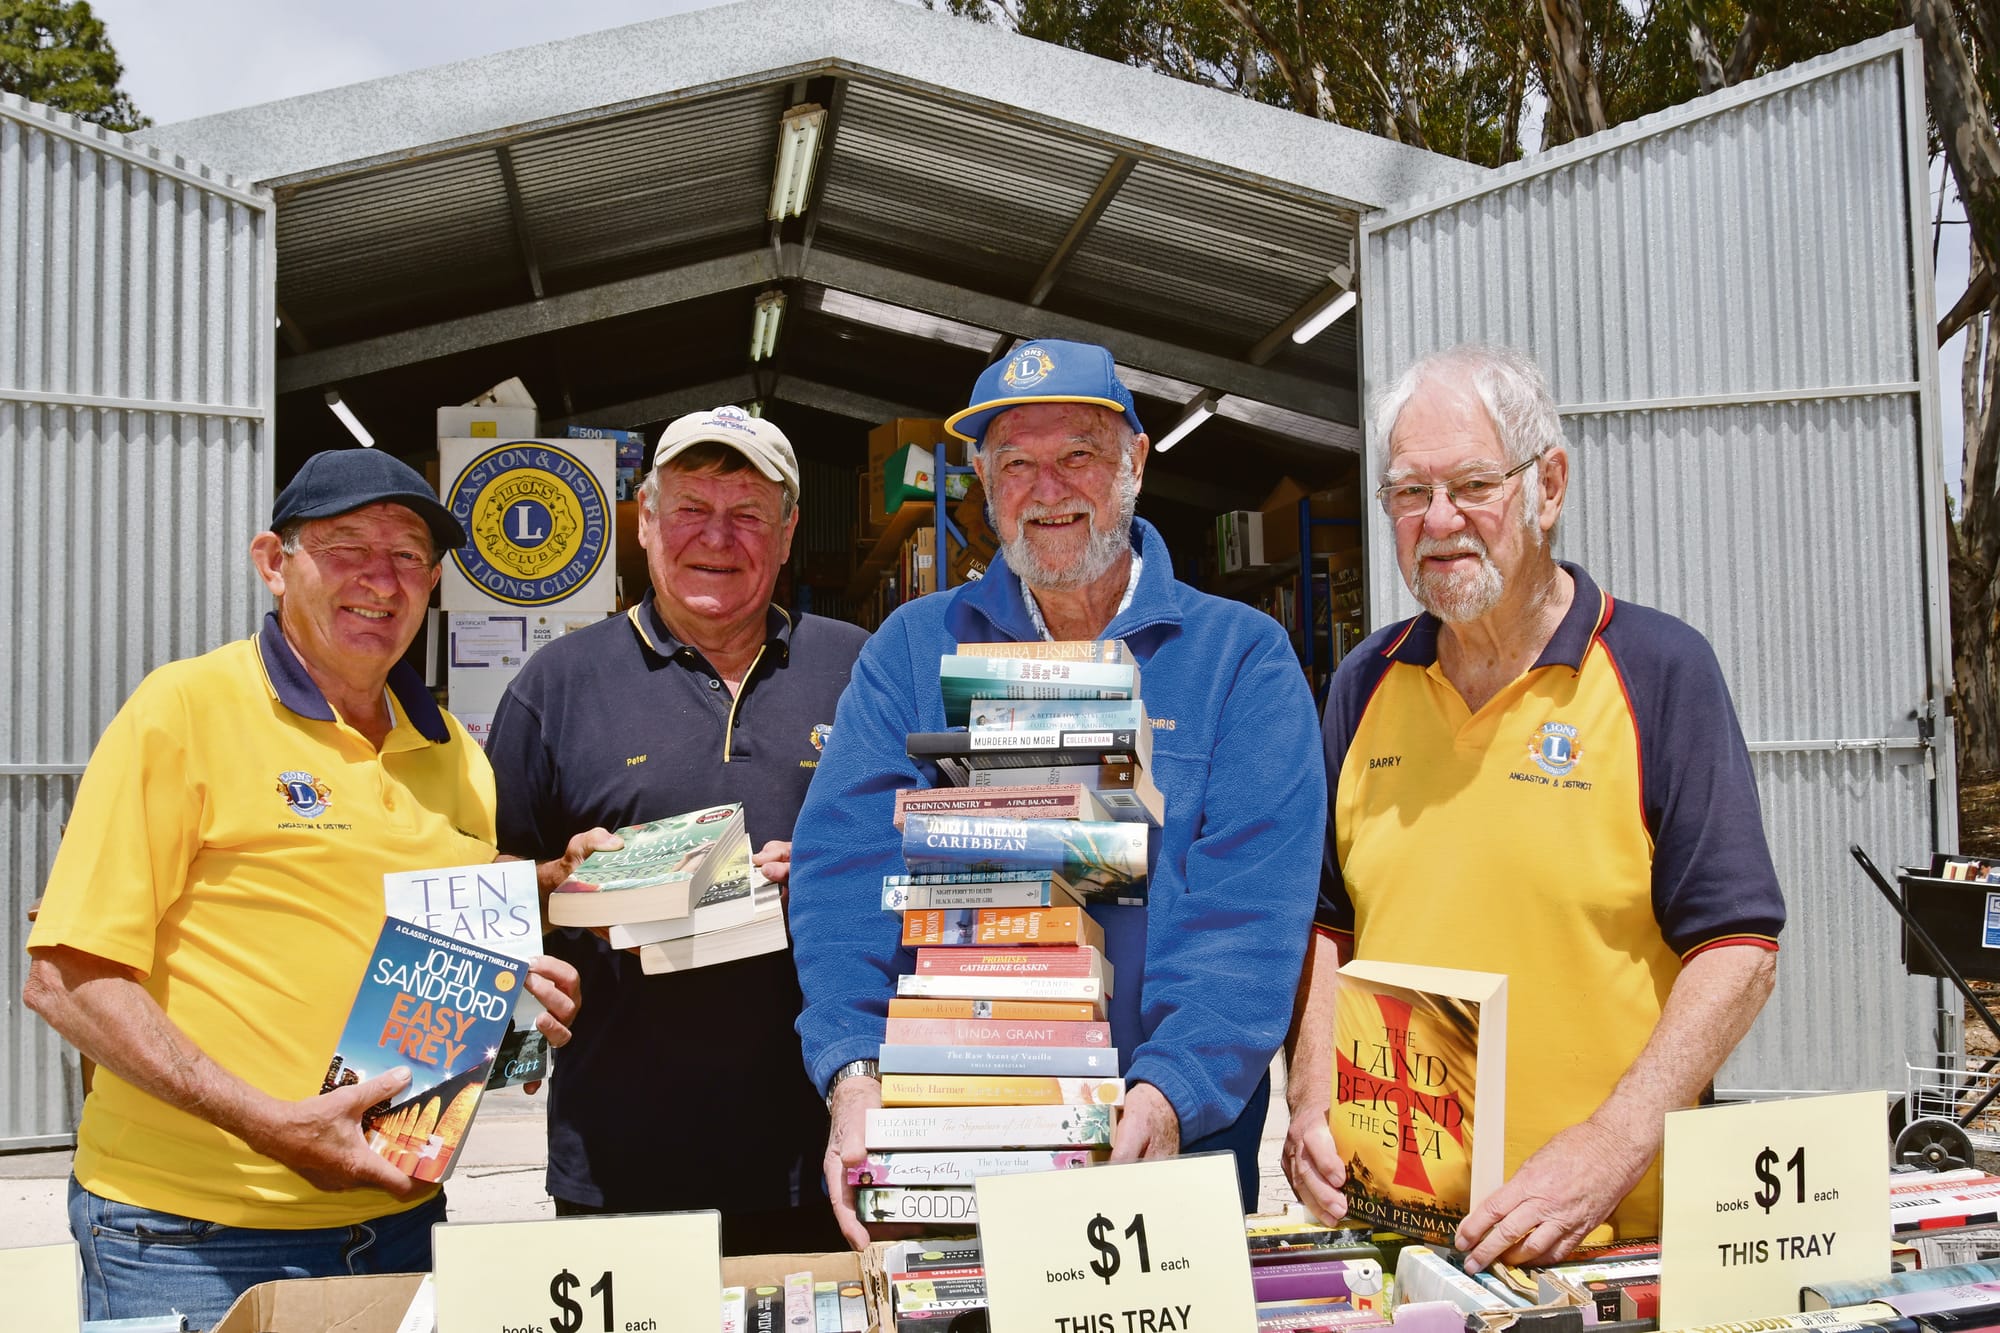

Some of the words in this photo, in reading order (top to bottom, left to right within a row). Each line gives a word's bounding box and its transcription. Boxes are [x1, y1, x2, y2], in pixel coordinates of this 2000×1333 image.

[1021, 360, 1035, 376] L
[579, 428, 603, 440] 500
[500, 481, 554, 500] LIONS
[535, 452, 549, 468] &
[555, 459, 602, 557] DISTRICT
[514, 505, 543, 539] L
[507, 551, 549, 564] CLUB
[470, 560, 535, 599] LIONS
[540, 560, 586, 596] CLUB
[1036, 643, 1097, 659] ERSKINE
[467, 723, 481, 732] No
[1543, 722, 1577, 738] LIONS
[974, 735, 1018, 746] MURDERER
[1020, 734, 1031, 746] NO
[1033, 735, 1056, 746] MORE
[1066, 736, 1094, 744] COLLEEN
[1548, 736, 1568, 761] L
[626, 754, 648, 767] Peter
[1369, 756, 1402, 769] BARRY
[280, 771, 313, 784] LIONS
[1508, 772, 1550, 785] ANGASTON
[1552, 779, 1559, 788] &
[1562, 780, 1592, 792] DISTRICT
[291, 784, 313, 804] L
[1027, 798, 1058, 806] BALANCE
[905, 802, 950, 811] ROHINTON
[951, 800, 981, 810] MISTRY
[927, 820, 963, 837] JAMES
[963, 823, 973, 837] A.
[974, 823, 1028, 838] MICHENER
[595, 835, 712, 861] THOMAS
[926, 834, 1027, 851] CARIBBEAN
[411, 871, 508, 913] TEN
[910, 918, 923, 938] TONY
[925, 912, 940, 943] PARSONS
[983, 912, 997, 928] Call
[998, 916, 1012, 928] the
[1012, 917, 1028, 934] High
[1026, 912, 1042, 940] Country
[982, 928, 996, 941] The
[998, 927, 1010, 936] of
[394, 924, 402, 932] A
[402, 926, 430, 942] CLASSIC
[429, 935, 451, 949] LUCAS
[450, 942, 488, 962] DAVENPORT
[487, 954, 519, 972] THRILLER
[415, 948, 483, 988] JOHN
[959, 963, 1013, 972] CATHERINE
[1013, 962, 1049, 972] GASKIN
[981, 955, 1028, 964] PROMISES
[373, 958, 508, 1022] SANDFORD
[388, 992, 477, 1042] EASY
[936, 1005, 965, 1013] River
[957, 1029, 1000, 1040] LINDA
[1006, 1029, 1054, 1040] GRANT
[1382, 1026, 1416, 1048] THE
[378, 1018, 468, 1070] PREY
[946, 1051, 964, 1060] The
[964, 1052, 984, 1060] Raw
[986, 1052, 1010, 1060] Scent
[1010, 1052, 1019, 1060] of
[1022, 1052, 1052, 1061] Vanilla
[1352, 1040, 1448, 1088] LAND
[504, 1058, 540, 1079] Catt
[892, 1084, 924, 1096] Wendy
[928, 1084, 965, 1094] Harmer
[1336, 1072, 1464, 1128] BEYOND
[877, 1119, 936, 1127] ELIZABETH
[884, 1128, 928, 1137] GILBERT
[1348, 1112, 1380, 1134] THE
[1382, 1119, 1445, 1160] SEA
[892, 1164, 931, 1180] Cathy
[934, 1162, 960, 1180] Kelly
[977, 1158, 992, 1166] The
[994, 1158, 1012, 1168] Year
[1014, 1158, 1029, 1166] that
[1716, 1198, 1750, 1213] books
[1754, 1146, 1806, 1214] $1
[1813, 1188, 1840, 1202] each
[1348, 1196, 1387, 1218] ARON
[1393, 1208, 1459, 1234] PENMAN
[1046, 1268, 1086, 1282] books
[1086, 1212, 1151, 1286] $1
[1160, 1257, 1190, 1271] each
[1718, 1240, 1770, 1267] THIS
[1776, 1232, 1836, 1261] TRAY
[550, 1268, 614, 1333] $1
[625, 1318, 657, 1332] each
[758, 1312, 772, 1330] ATLAS
[1054, 1312, 1115, 1333] THIS
[1122, 1304, 1192, 1333] TRAY
[1801, 1318, 1814, 1326] OF
[1816, 1314, 1840, 1324] TIME
